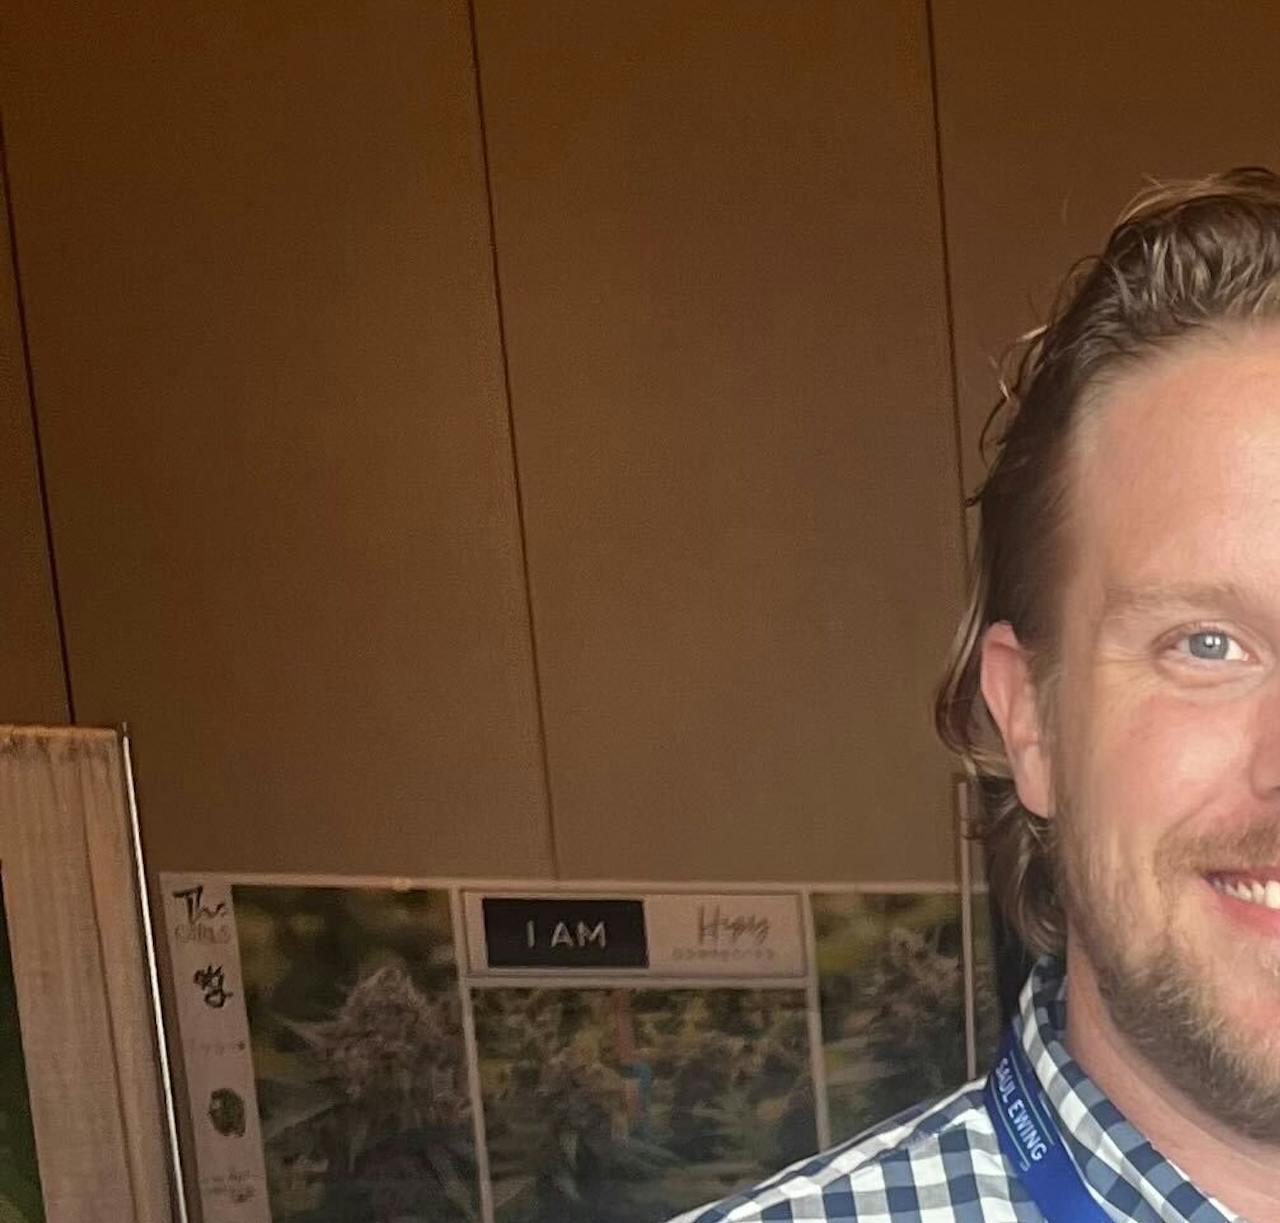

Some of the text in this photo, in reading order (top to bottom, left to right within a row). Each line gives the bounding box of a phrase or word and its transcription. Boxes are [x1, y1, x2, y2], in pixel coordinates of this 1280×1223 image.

[526, 920, 607, 948] I AM
[996, 1058, 1048, 1161] SAUL EWING
